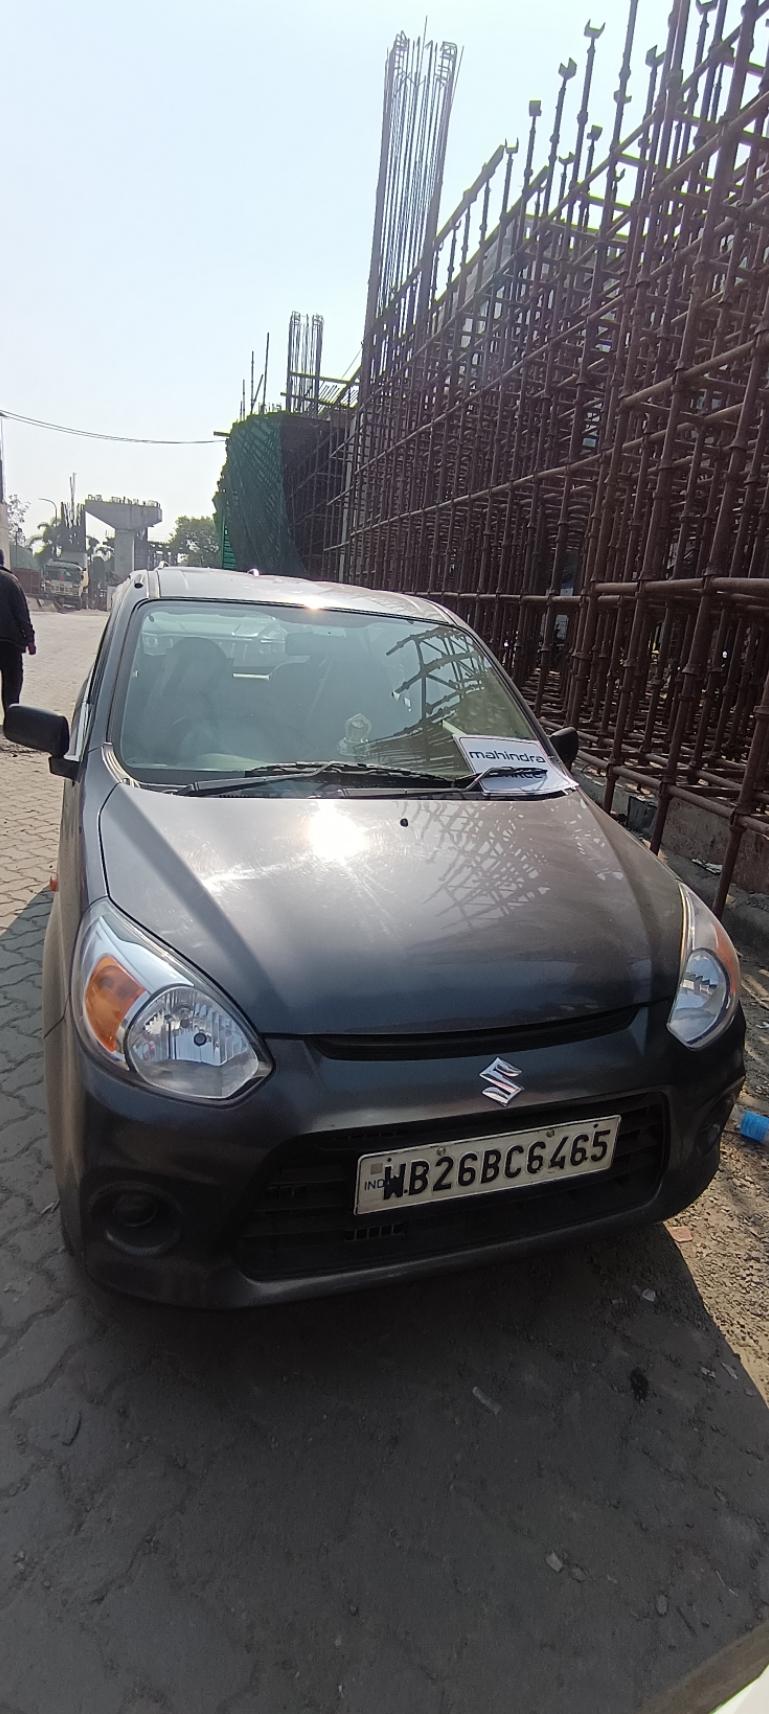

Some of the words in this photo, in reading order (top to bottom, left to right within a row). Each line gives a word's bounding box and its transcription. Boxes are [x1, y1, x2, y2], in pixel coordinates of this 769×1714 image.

[469, 750, 546, 763] mahindra
[383, 1130, 611, 1200] WB26BC6465
[364, 1178, 385, 1191] IND
